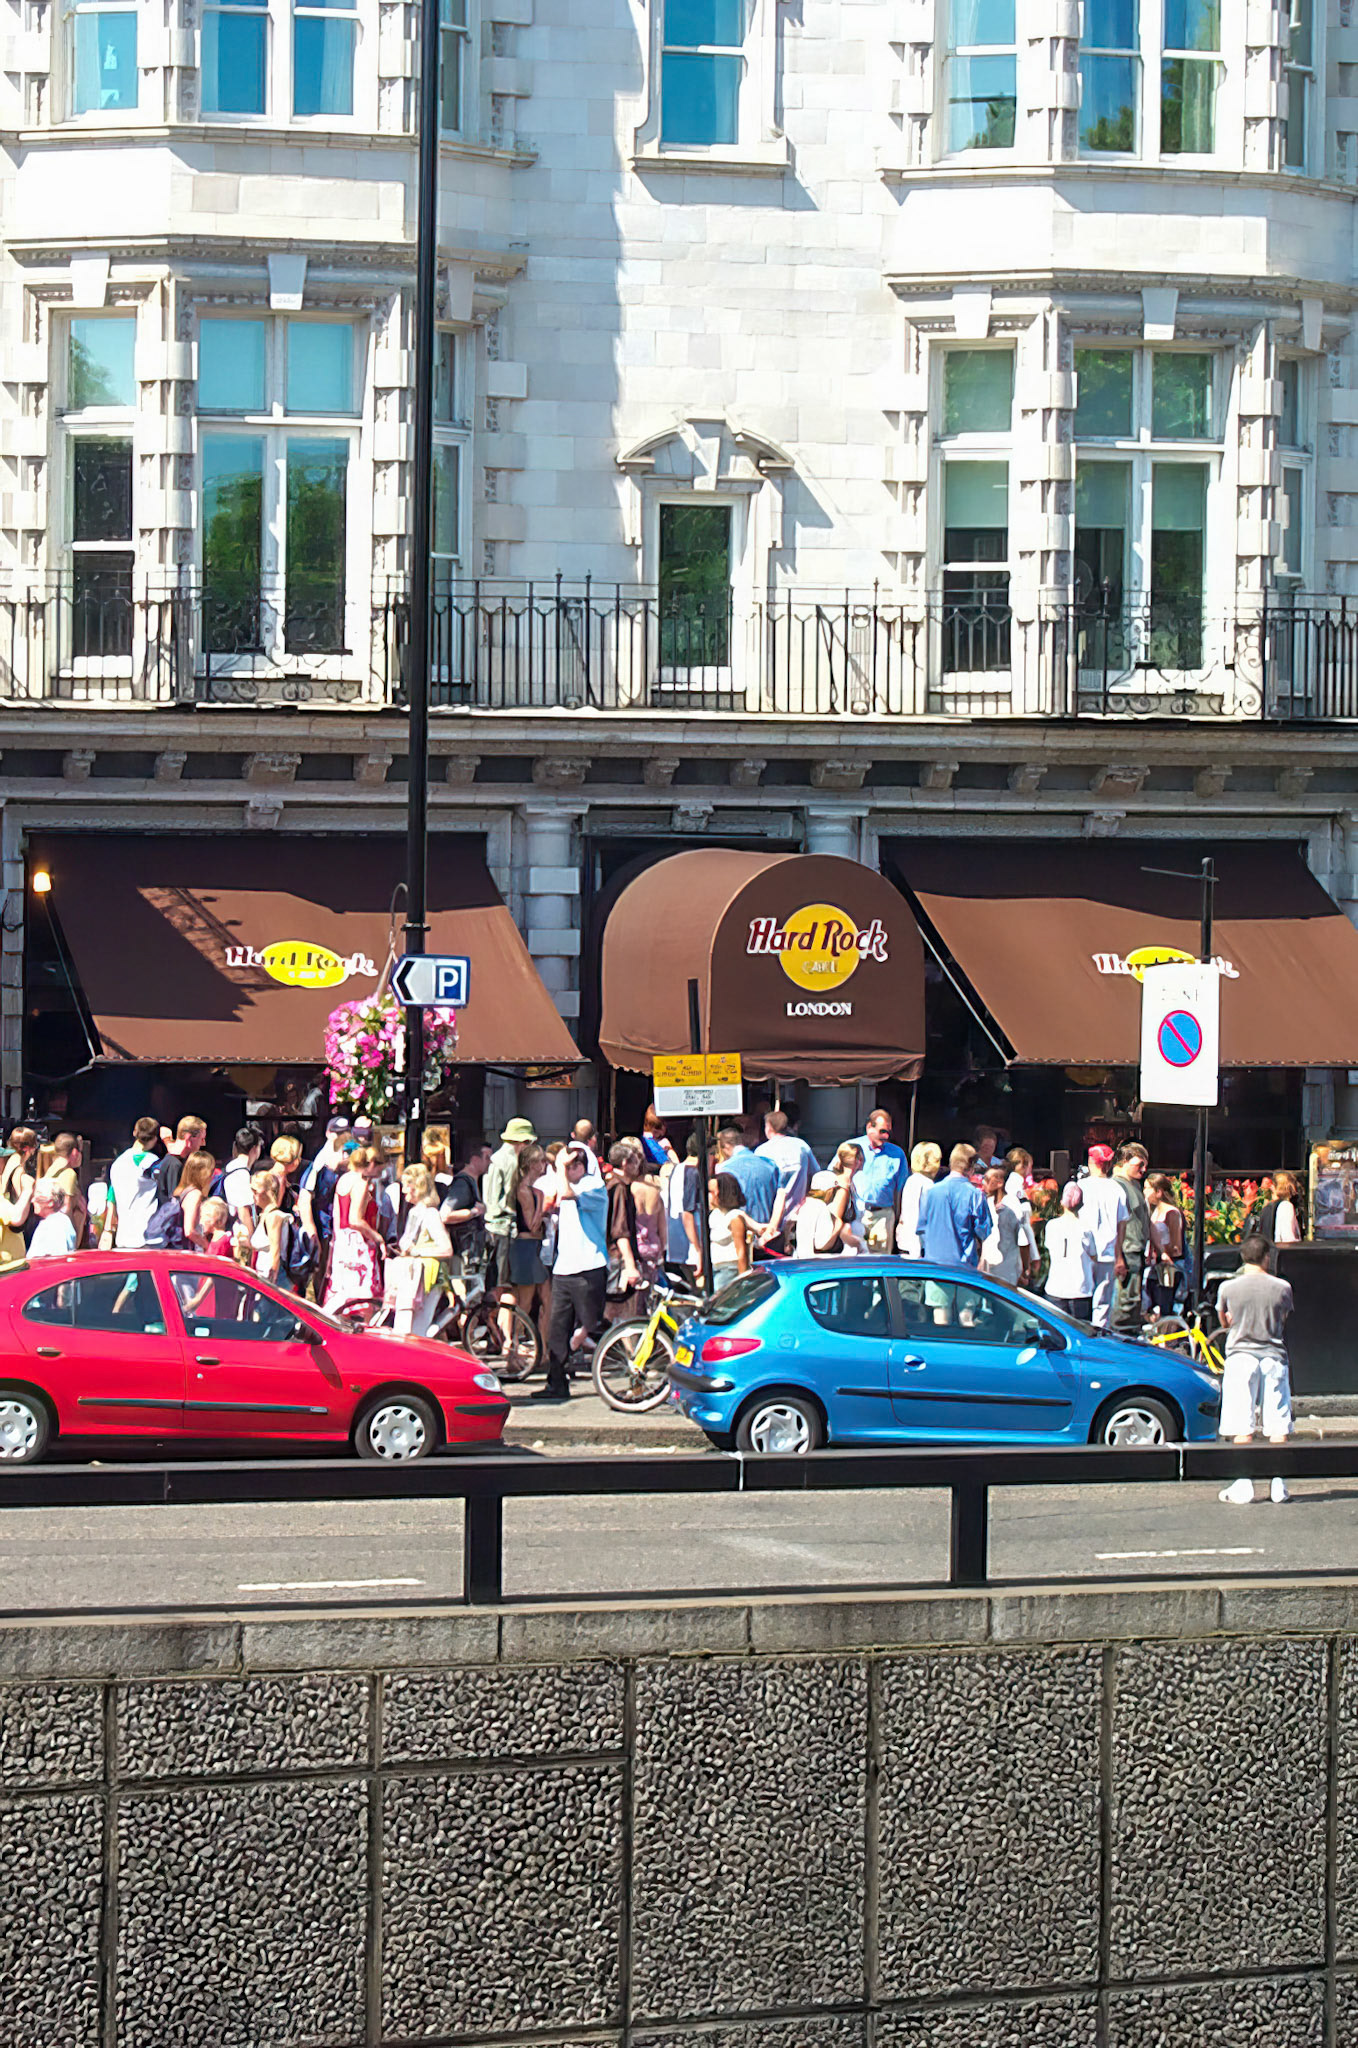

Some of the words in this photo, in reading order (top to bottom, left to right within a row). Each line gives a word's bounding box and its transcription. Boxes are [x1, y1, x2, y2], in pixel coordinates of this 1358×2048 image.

[747, 918, 818, 953] Hard
[821, 919, 888, 962] Rock
[438, 968, 459, 997] P
[787, 1002, 852, 1016] LONDON
